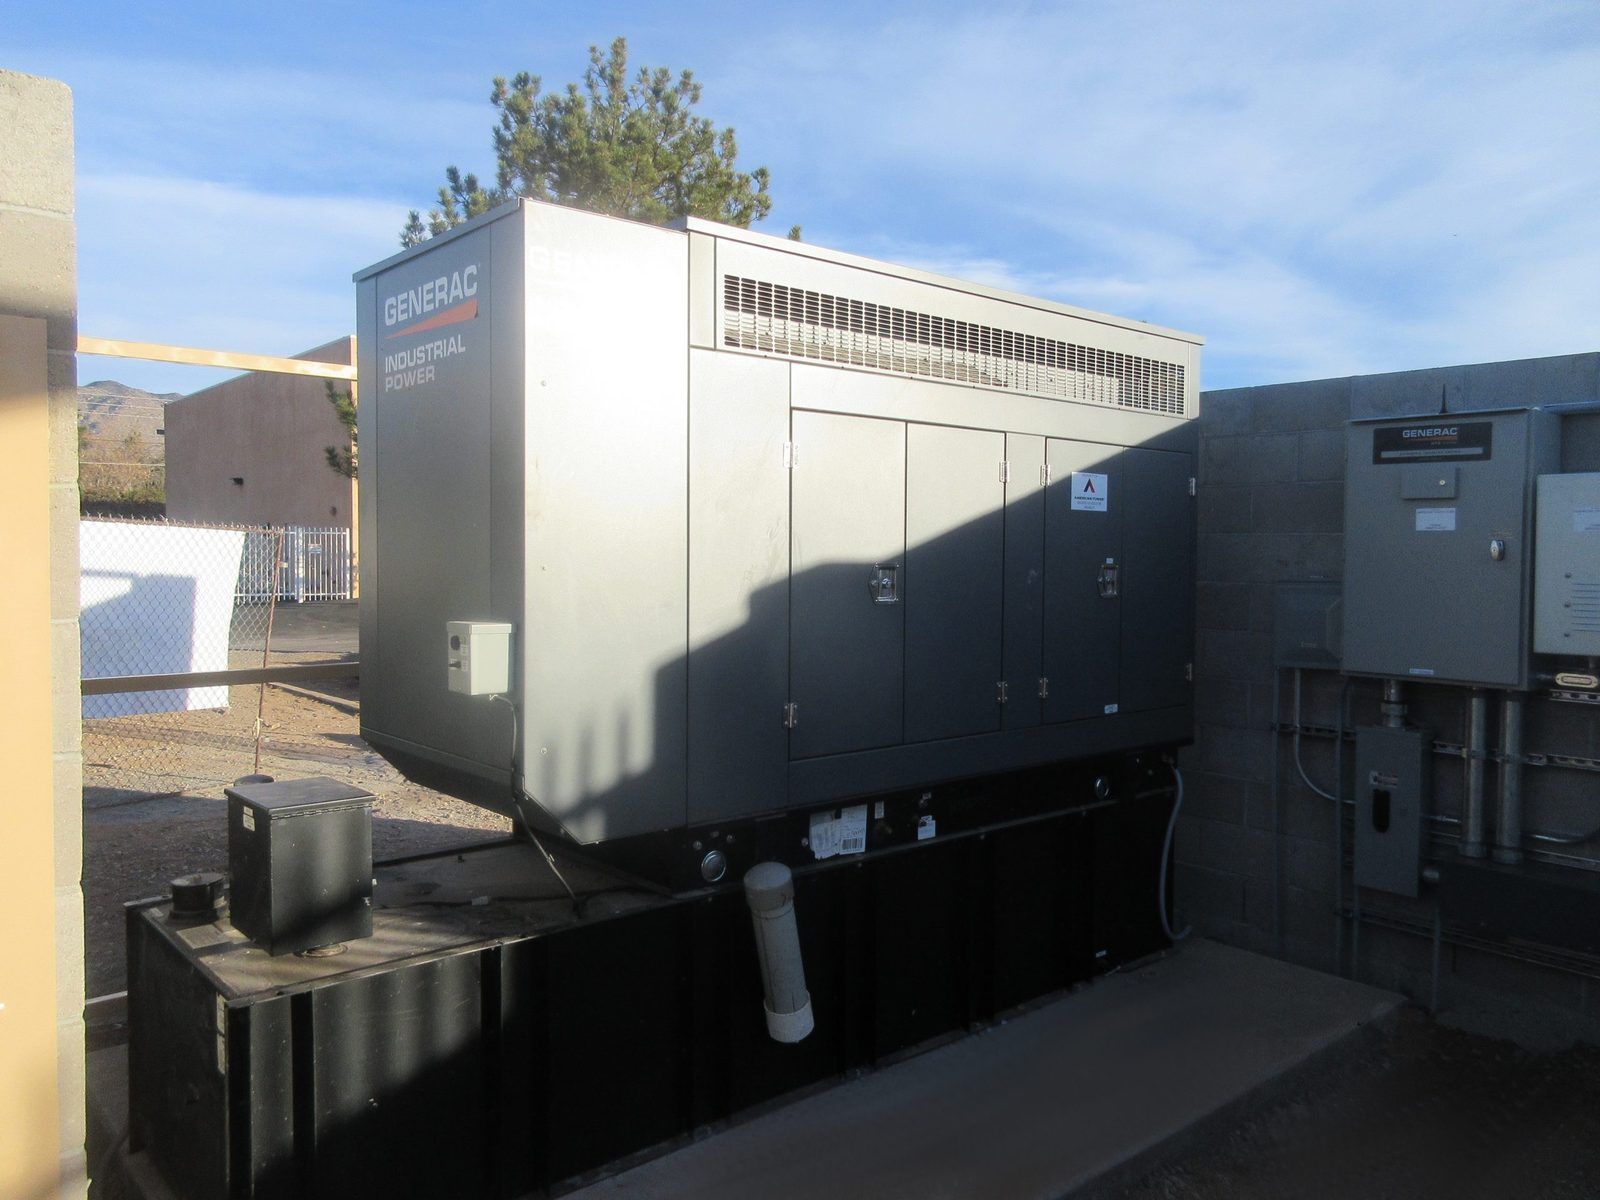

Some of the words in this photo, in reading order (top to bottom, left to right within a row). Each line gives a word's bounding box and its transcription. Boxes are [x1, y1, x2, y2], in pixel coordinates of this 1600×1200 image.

[385, 264, 478, 326] GENERAC
[385, 334, 466, 374] INDUSTRIAL
[385, 365, 436, 392] POWER
[1402, 427, 1458, 438] GENERAC
